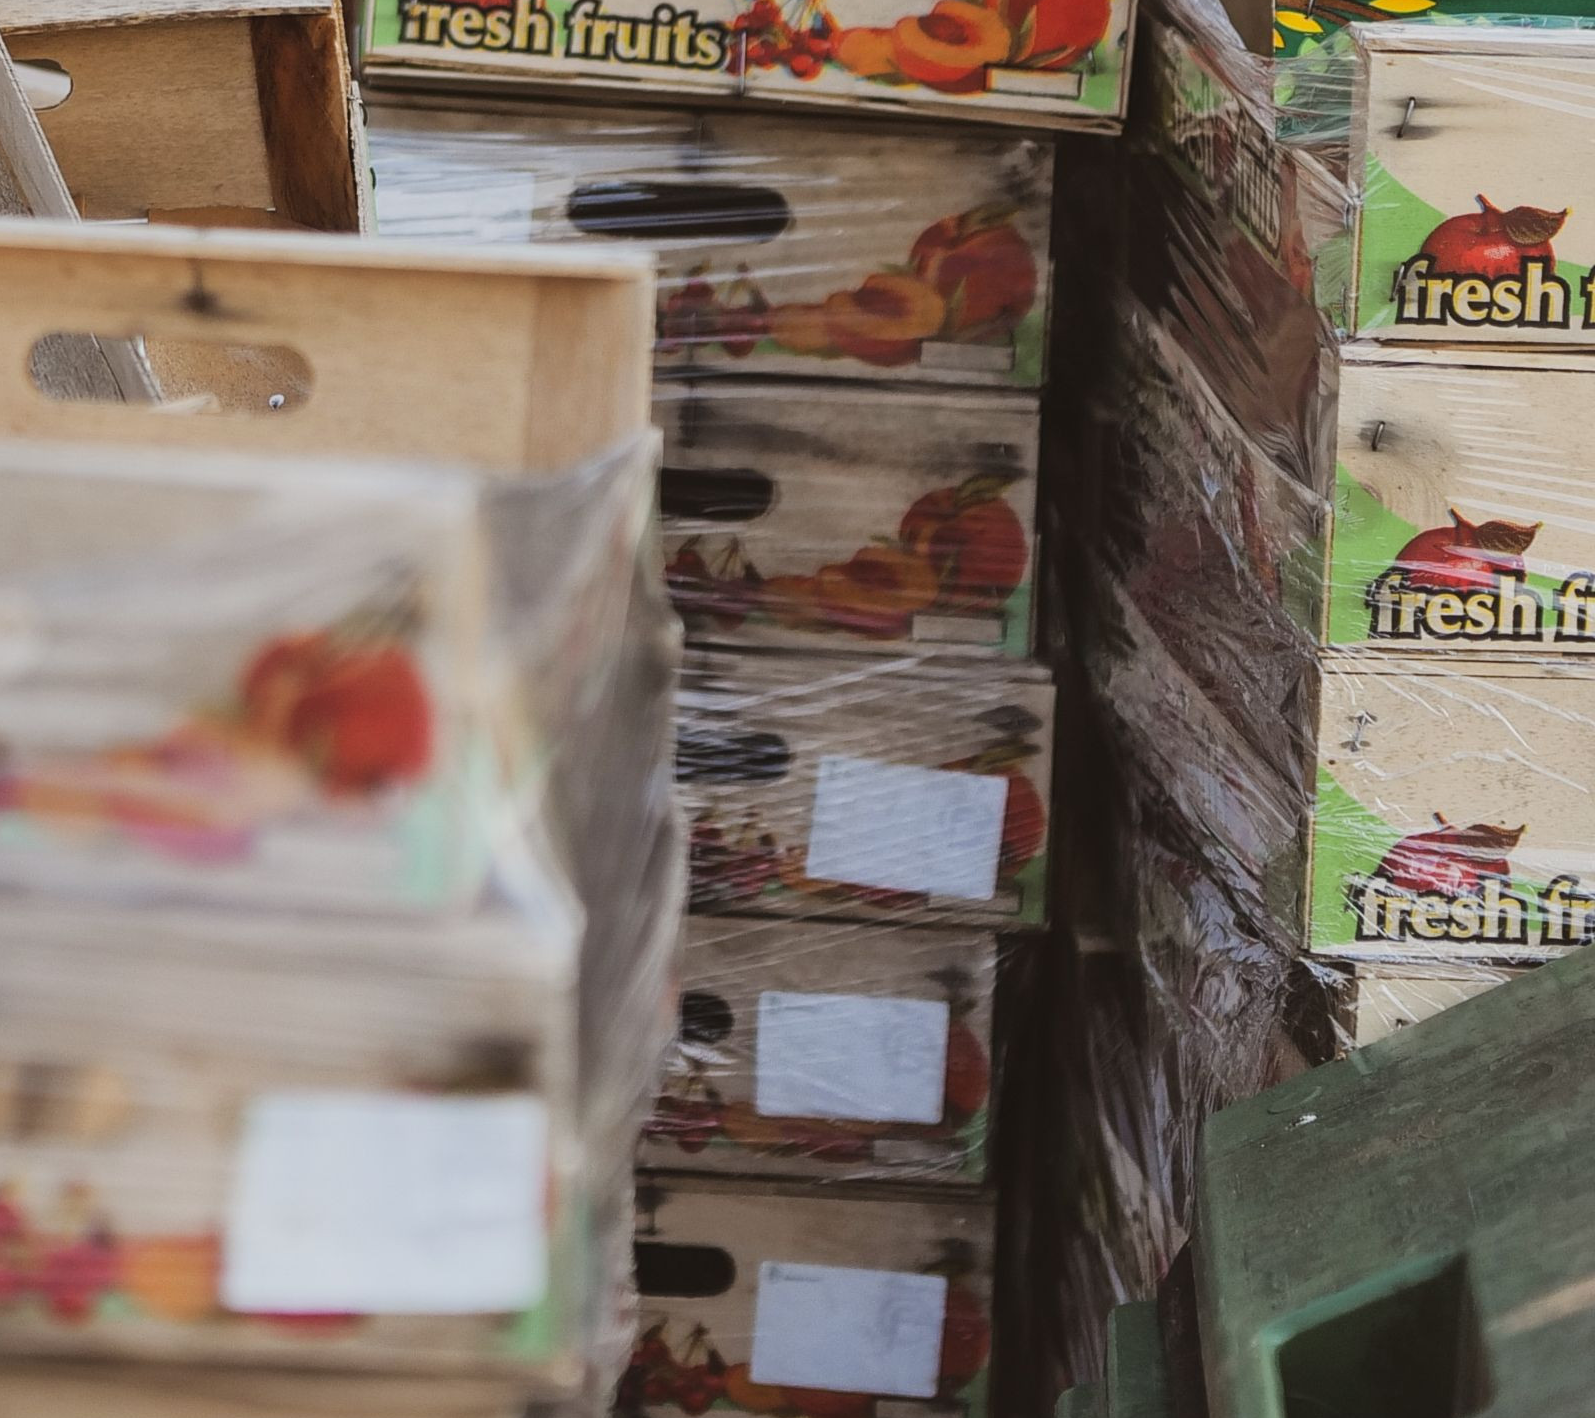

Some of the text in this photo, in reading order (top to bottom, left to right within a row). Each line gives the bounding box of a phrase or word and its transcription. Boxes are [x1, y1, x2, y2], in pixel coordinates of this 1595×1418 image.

[1400, 256, 1569, 328] fresh
[1369, 571, 1541, 641] fresh
[1347, 874, 1529, 944] fresh
